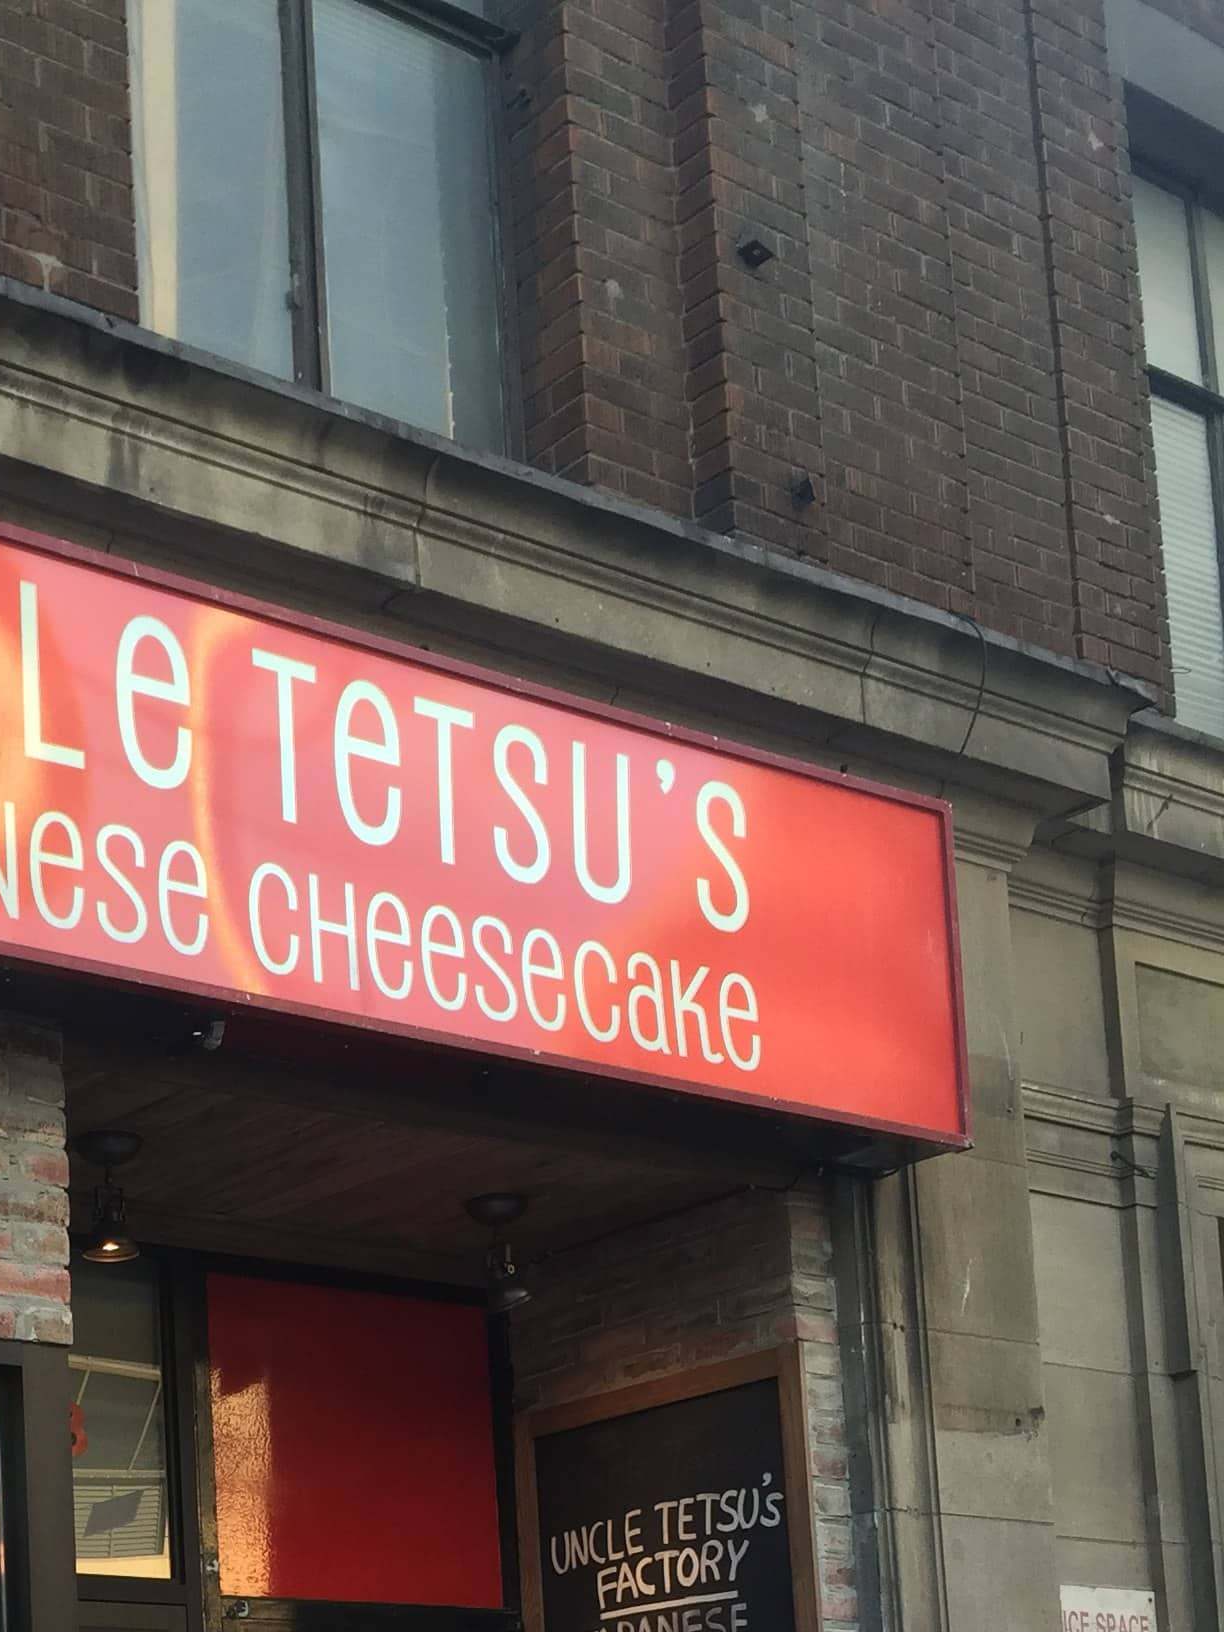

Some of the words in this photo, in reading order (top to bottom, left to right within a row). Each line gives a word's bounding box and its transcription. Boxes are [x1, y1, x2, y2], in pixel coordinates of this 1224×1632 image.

[551, 1509, 644, 1575] UNCLE
[653, 1472, 785, 1546] TETSU'S
[596, 1538, 750, 1610] FACTORY
